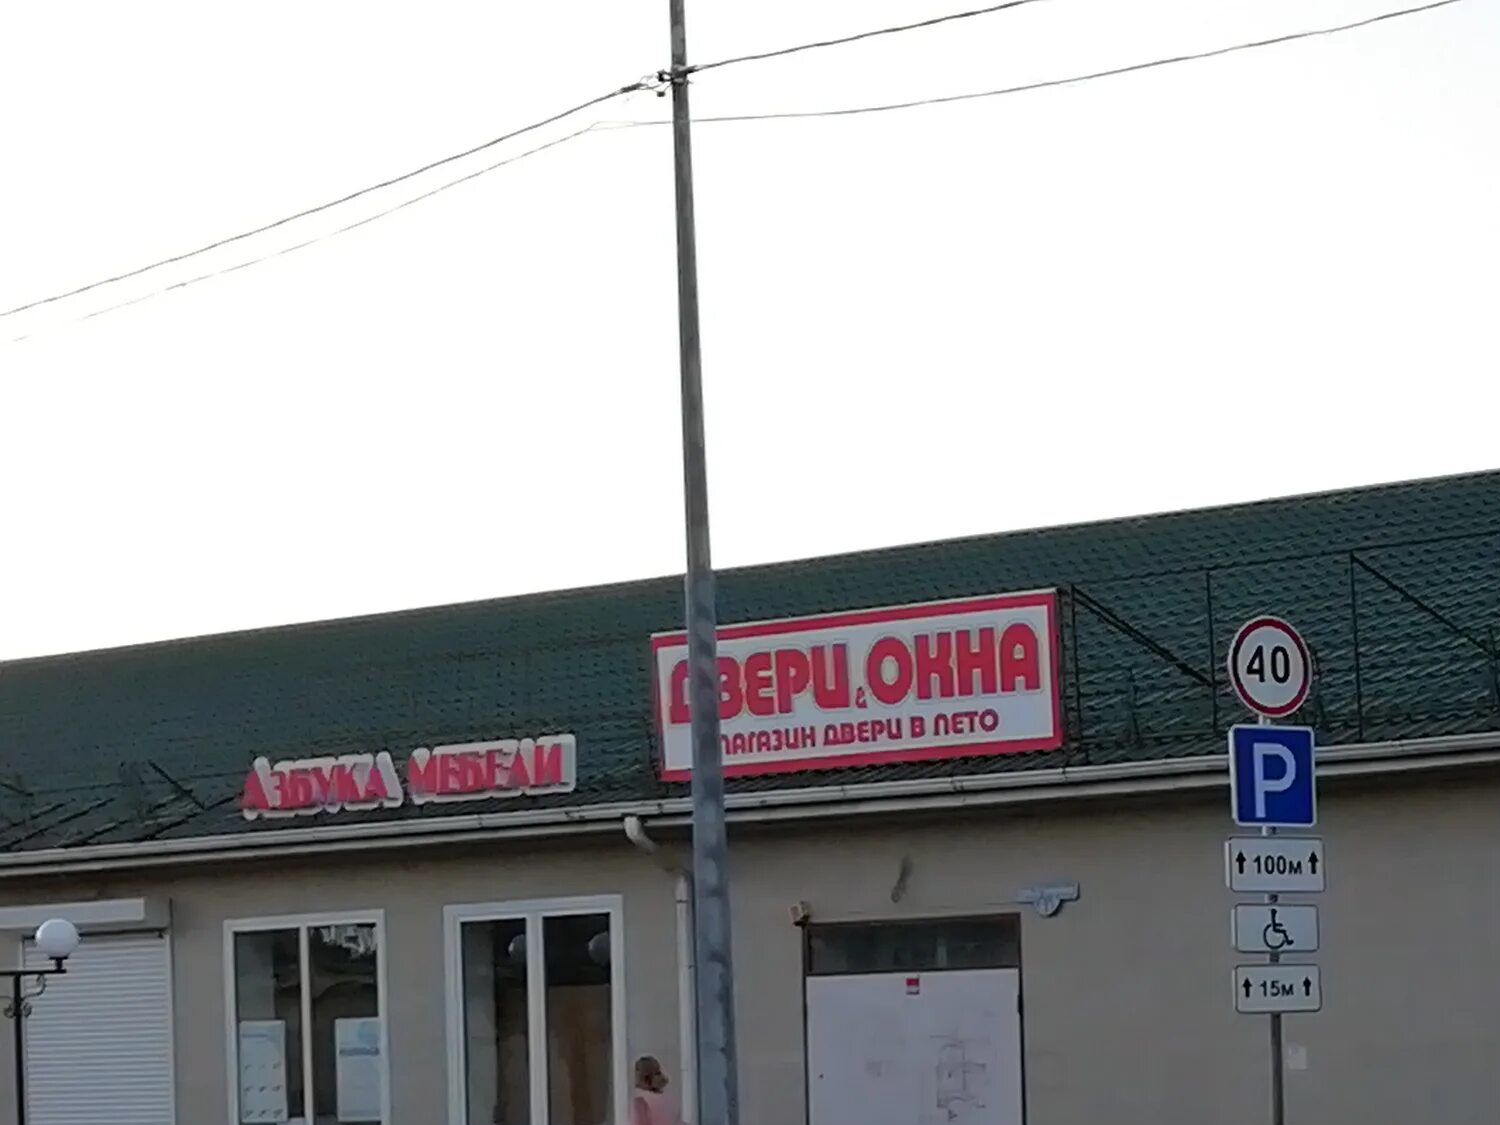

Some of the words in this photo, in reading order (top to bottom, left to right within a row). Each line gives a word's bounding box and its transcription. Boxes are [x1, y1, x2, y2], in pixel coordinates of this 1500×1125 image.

[867, 622, 1039, 704] ОКНА
[1246, 645, 1290, 684] 40
[824, 717, 901, 746] ДВЕРИ
[911, 715, 924, 738] В
[934, 708, 998, 736] ЛЕТО
[242, 763, 392, 811] АЗБУКА
[409, 743, 566, 797] МЕБЕЛИ
[1253, 742, 1296, 818] P
